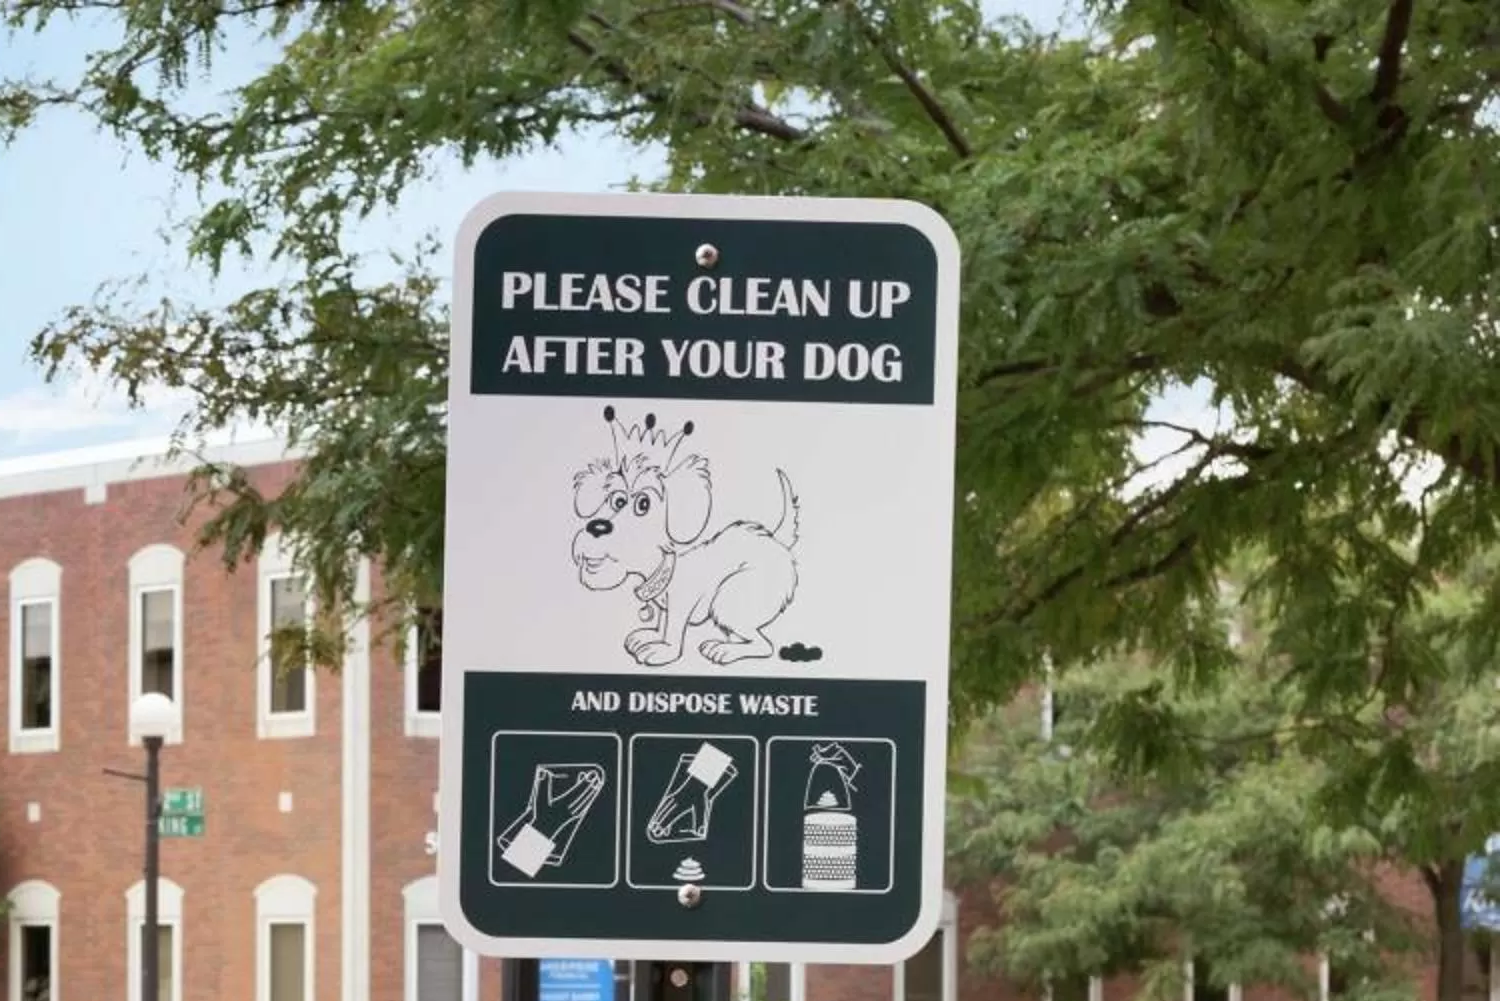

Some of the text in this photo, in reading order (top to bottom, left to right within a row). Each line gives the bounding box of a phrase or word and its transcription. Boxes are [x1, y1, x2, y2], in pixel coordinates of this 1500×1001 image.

[502, 272, 912, 319] PLEASE CLEAN UP
[502, 335, 903, 383] AFTER YOUR DOG
[571, 690, 819, 717] AND DISPOSE WASTE
